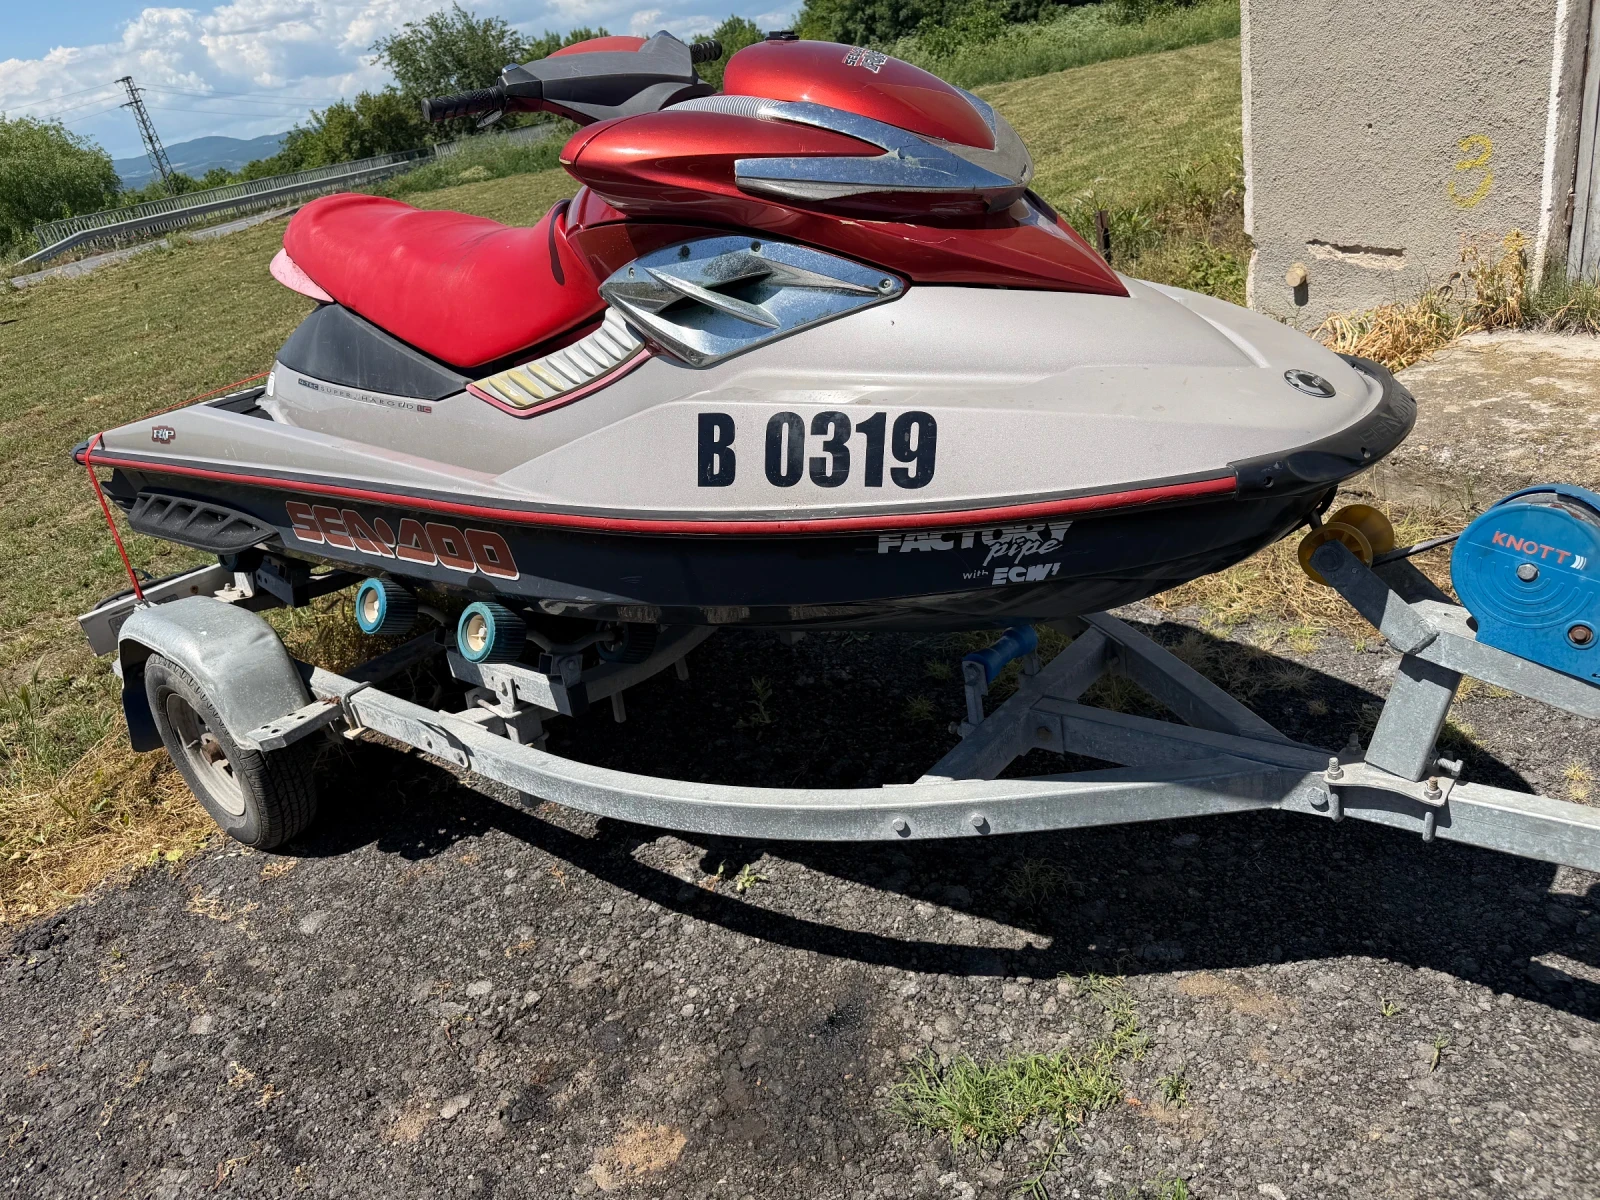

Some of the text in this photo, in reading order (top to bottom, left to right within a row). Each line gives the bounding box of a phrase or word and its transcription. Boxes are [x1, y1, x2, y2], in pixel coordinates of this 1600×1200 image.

[1447, 134, 1494, 208] 3
[697, 411, 938, 490] B 0319
[982, 536, 1063, 567] pipe
[1491, 530, 1571, 565] KNOTT
[962, 569, 989, 580] with
